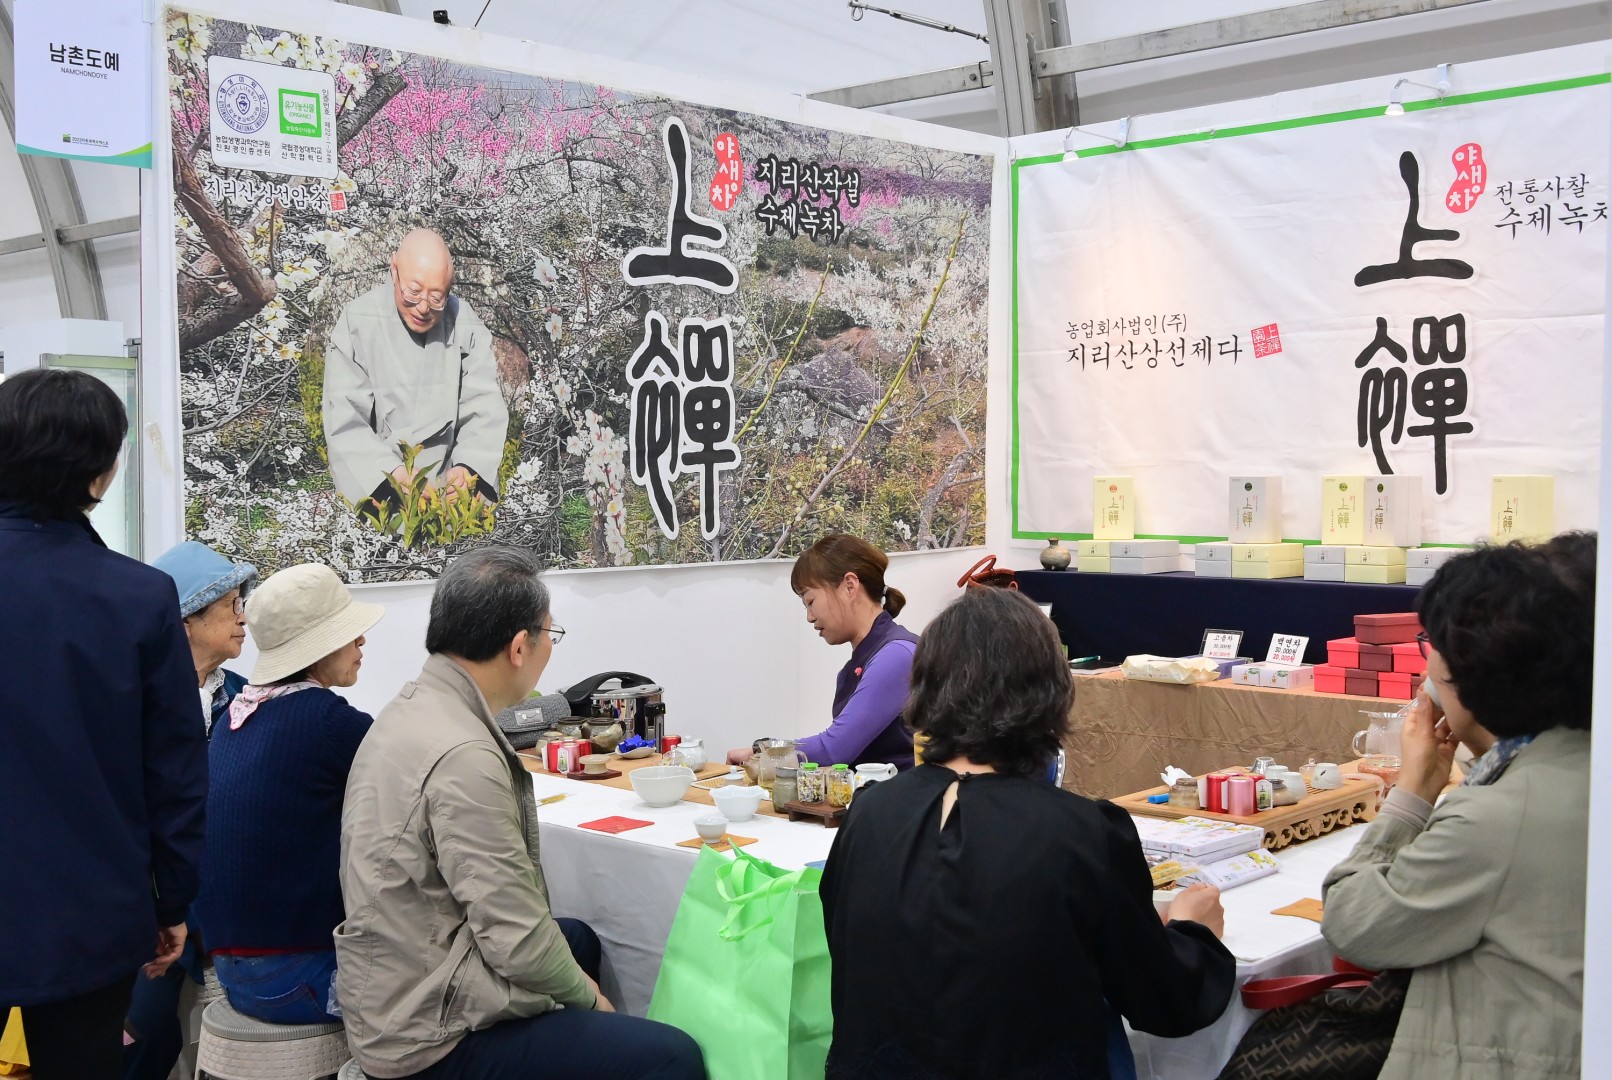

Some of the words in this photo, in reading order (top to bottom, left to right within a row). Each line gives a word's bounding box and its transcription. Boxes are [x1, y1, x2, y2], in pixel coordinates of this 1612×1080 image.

[49, 42, 119, 71] 남촌도예
[60, 67, 108, 80] NAMCHONDOYE
[285, 100, 315, 113] 유기농산물
[215, 135, 271, 149] 농업생명과학연구원
[215, 143, 271, 157] 친환경인증센터
[281, 142, 323, 155] 국립경상대학교
[711, 136, 740, 209] 야생차
[1449, 145, 1482, 211] 야생차
[1494, 172, 1590, 206] 전통사찰
[1065, 312, 1187, 340] 농업회사법인(주)
[1065, 334, 1243, 372] 지리산상선제다
